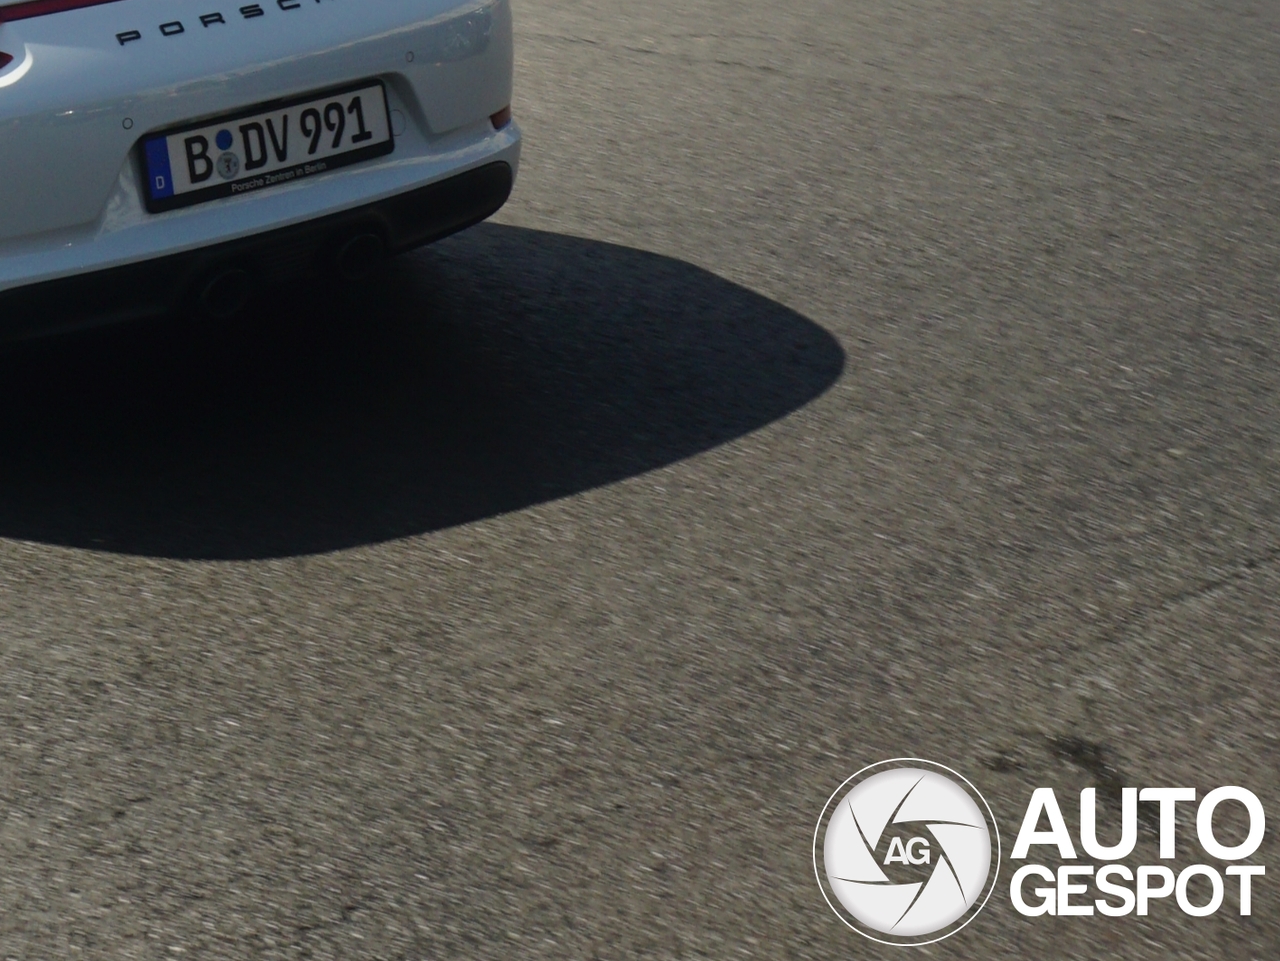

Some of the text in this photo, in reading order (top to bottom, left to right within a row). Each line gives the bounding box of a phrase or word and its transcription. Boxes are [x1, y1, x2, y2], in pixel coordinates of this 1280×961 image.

[184, 96, 373, 184] B DV 991
[155, 175, 165, 190] D
[231, 162, 327, 193] Porsche Zentren in Berlin
